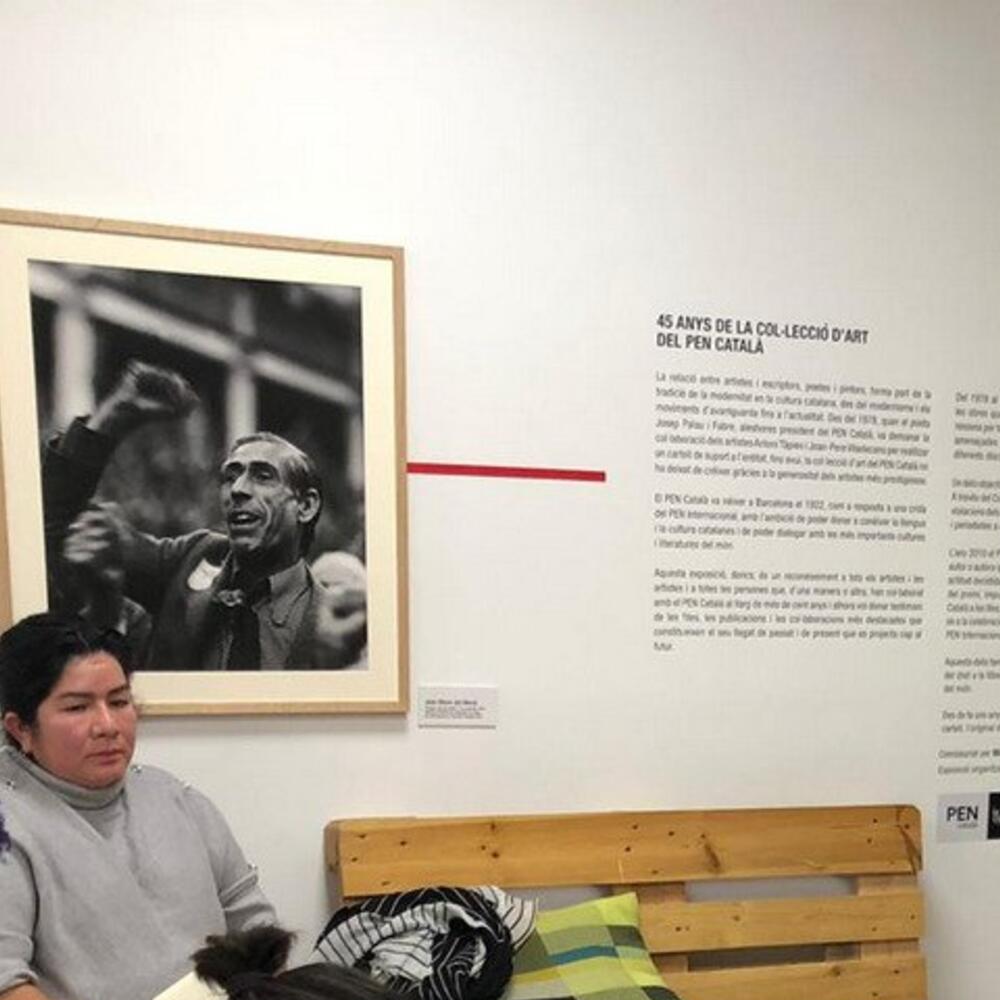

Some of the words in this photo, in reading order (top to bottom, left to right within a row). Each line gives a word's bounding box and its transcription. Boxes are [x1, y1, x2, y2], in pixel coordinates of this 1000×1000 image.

[656, 314, 673, 329] 45
[676, 315, 712, 333] ANYS
[715, 317, 734, 334] DE
[736, 319, 753, 335] LA
[831, 326, 869, 345] D'ART
[656, 332, 682, 349] DEL
[685, 334, 711, 351] PEN
[715, 335, 765, 355] CATALÀ
[831, 428, 847, 437] PEN
[879, 459, 894, 468] PEN
[664, 494, 681, 503] PEN
[668, 509, 685, 518] PEN
[681, 598, 698, 606] PEN
[946, 805, 979, 822] PEN
